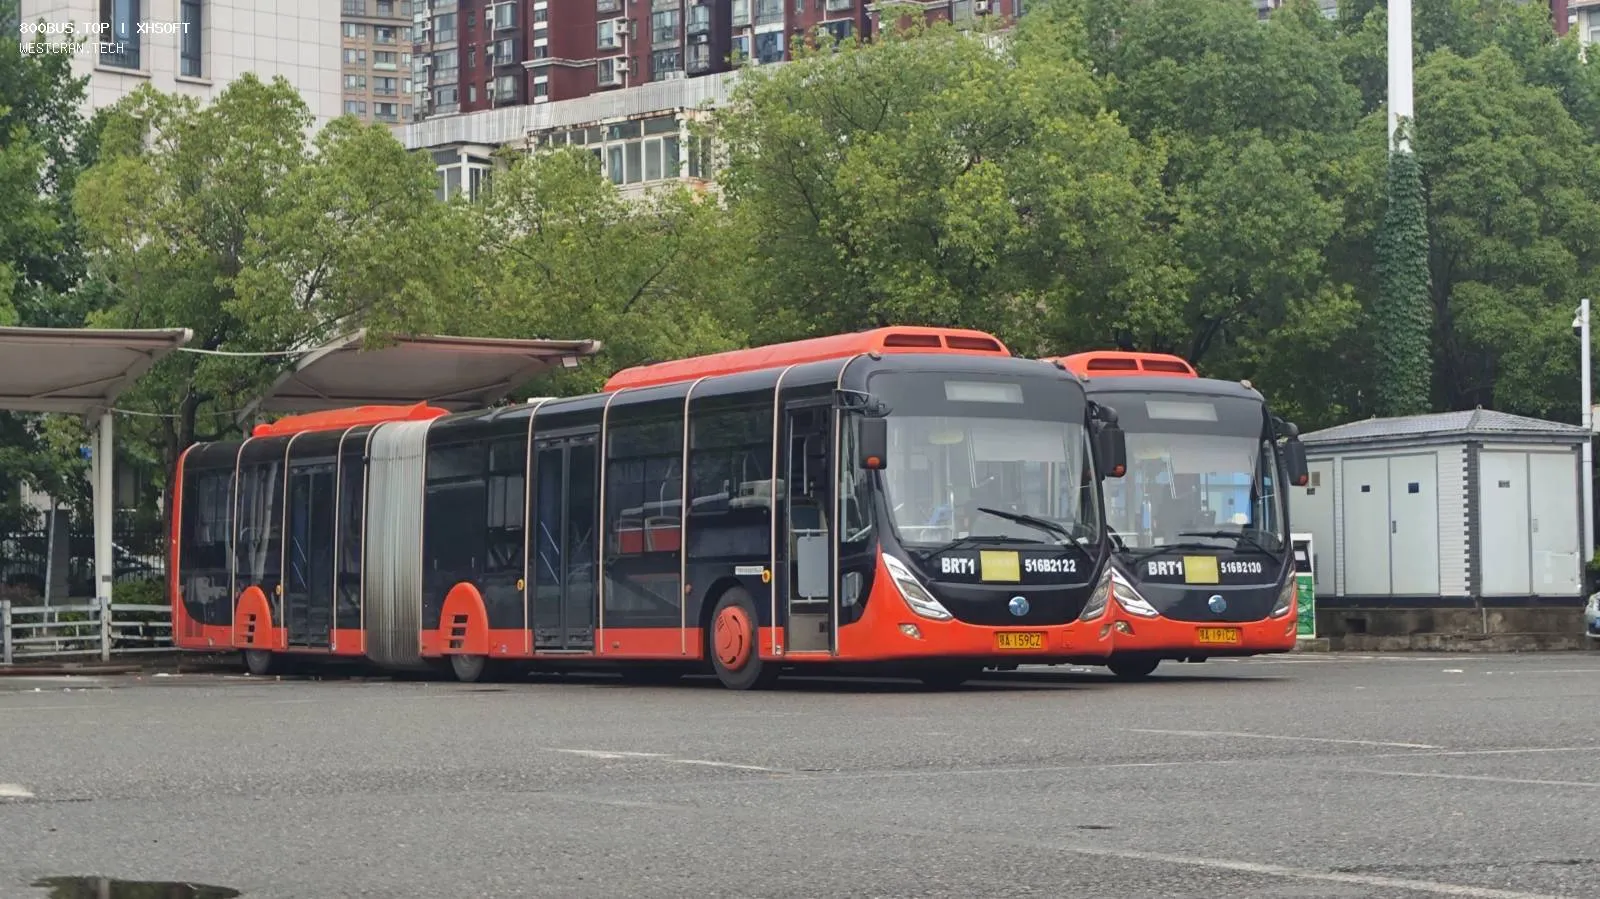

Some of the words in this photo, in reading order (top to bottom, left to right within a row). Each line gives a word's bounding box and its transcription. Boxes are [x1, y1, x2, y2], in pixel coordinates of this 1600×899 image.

[941, 557, 975, 574] BRT1
[1024, 559, 1076, 572] 516B2122
[1147, 561, 1183, 575] BRT1
[1220, 561, 1261, 572] 516B2130
